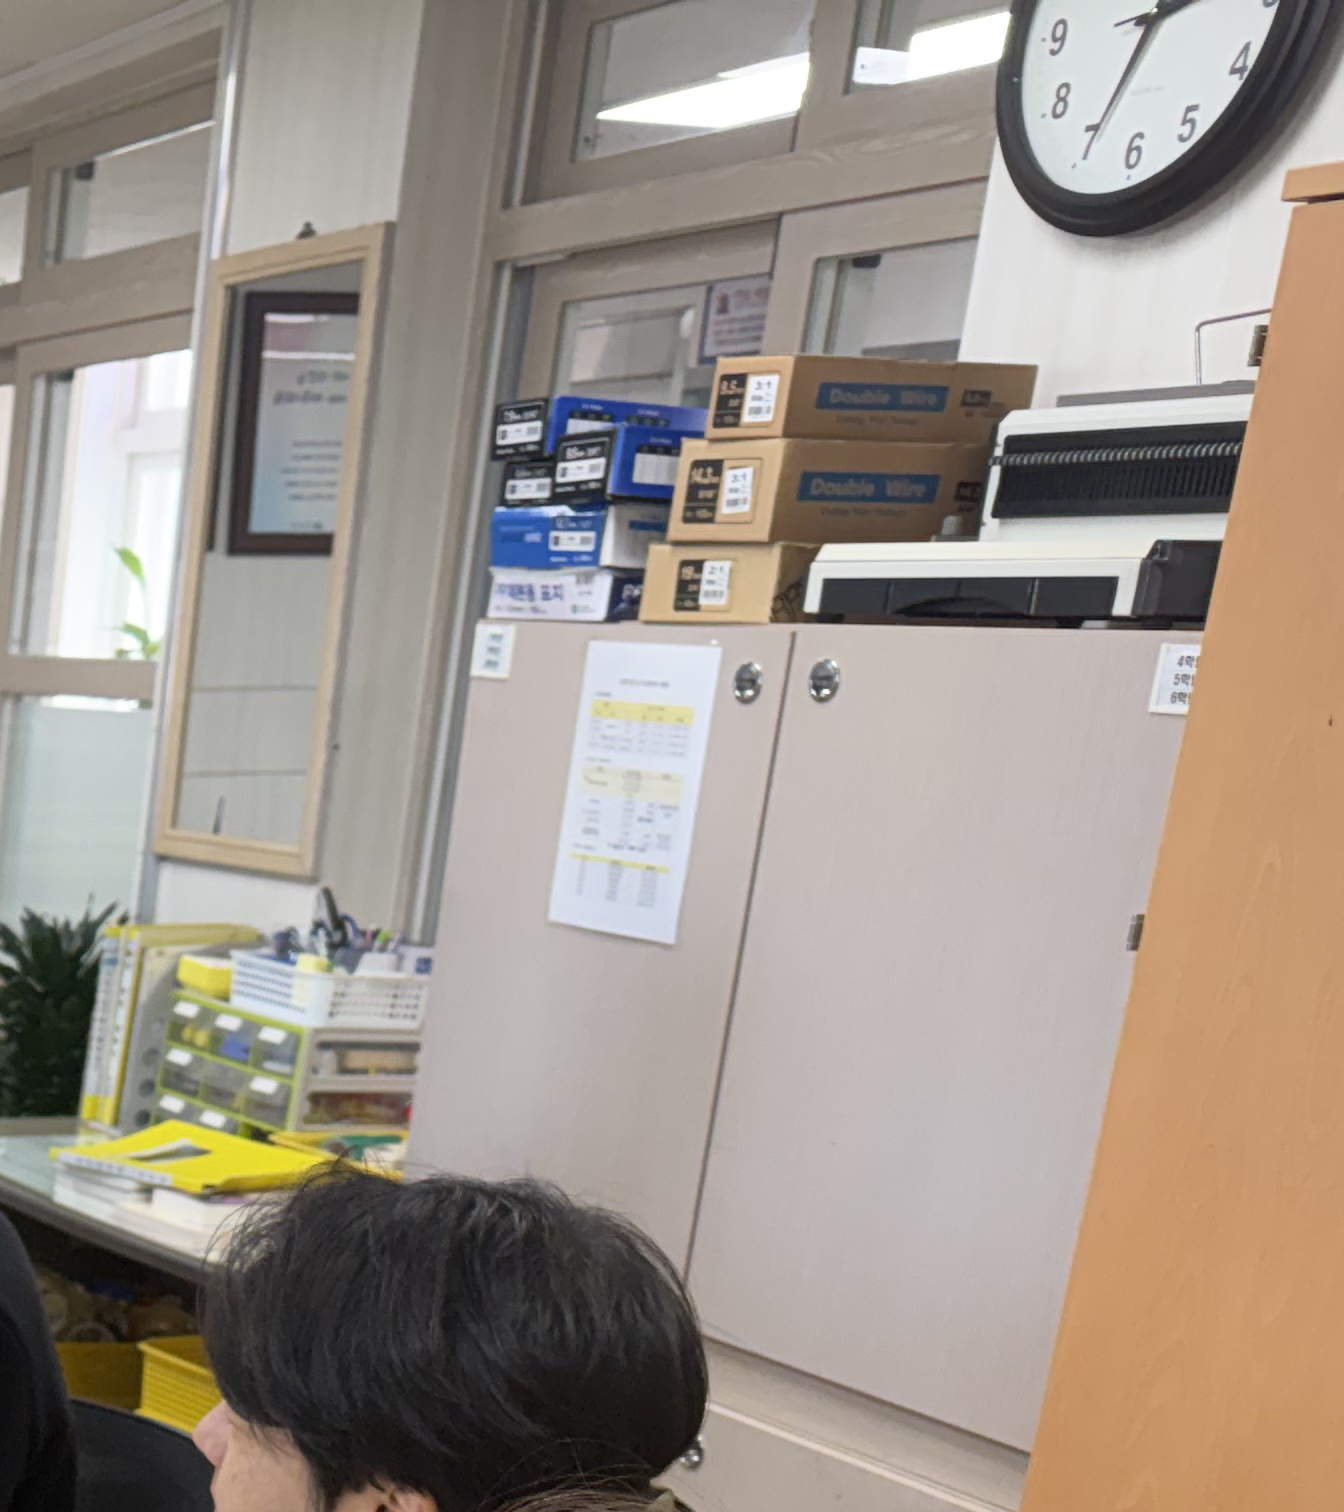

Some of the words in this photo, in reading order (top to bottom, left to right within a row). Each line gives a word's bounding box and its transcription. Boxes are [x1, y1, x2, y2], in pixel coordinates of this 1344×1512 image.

[1049, 18, 1069, 57] 9
[1228, 41, 1252, 81] 4
[1051, 82, 1071, 120] 8
[1082, 123, 1101, 161] 7
[1177, 104, 1200, 143] 5
[1124, 131, 1145, 169] 6
[755, 380, 772, 391] 3:1
[829, 387, 891, 405] Double
[900, 390, 939, 406] Wire
[731, 473, 748, 484] 3:1
[811, 477, 876, 497] Double
[886, 479, 928, 498] Wire
[1170, 691, 1192, 704] 6학
